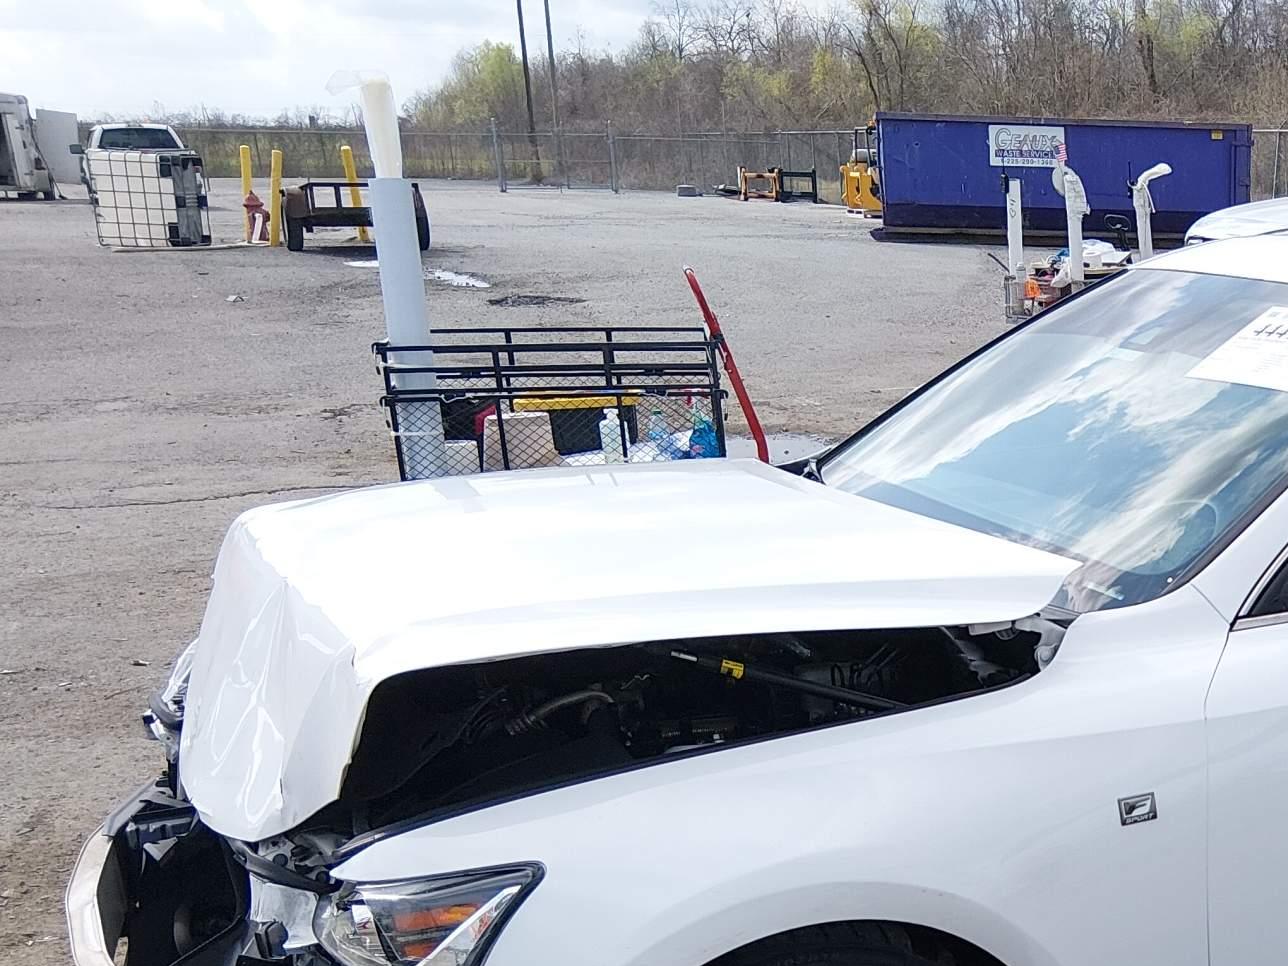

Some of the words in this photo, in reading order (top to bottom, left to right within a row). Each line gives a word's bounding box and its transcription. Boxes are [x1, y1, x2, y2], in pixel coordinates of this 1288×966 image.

[995, 128, 1056, 150] GEAUX
[996, 150, 1021, 158] WASTE
[1125, 812, 1155, 825] SPORT
